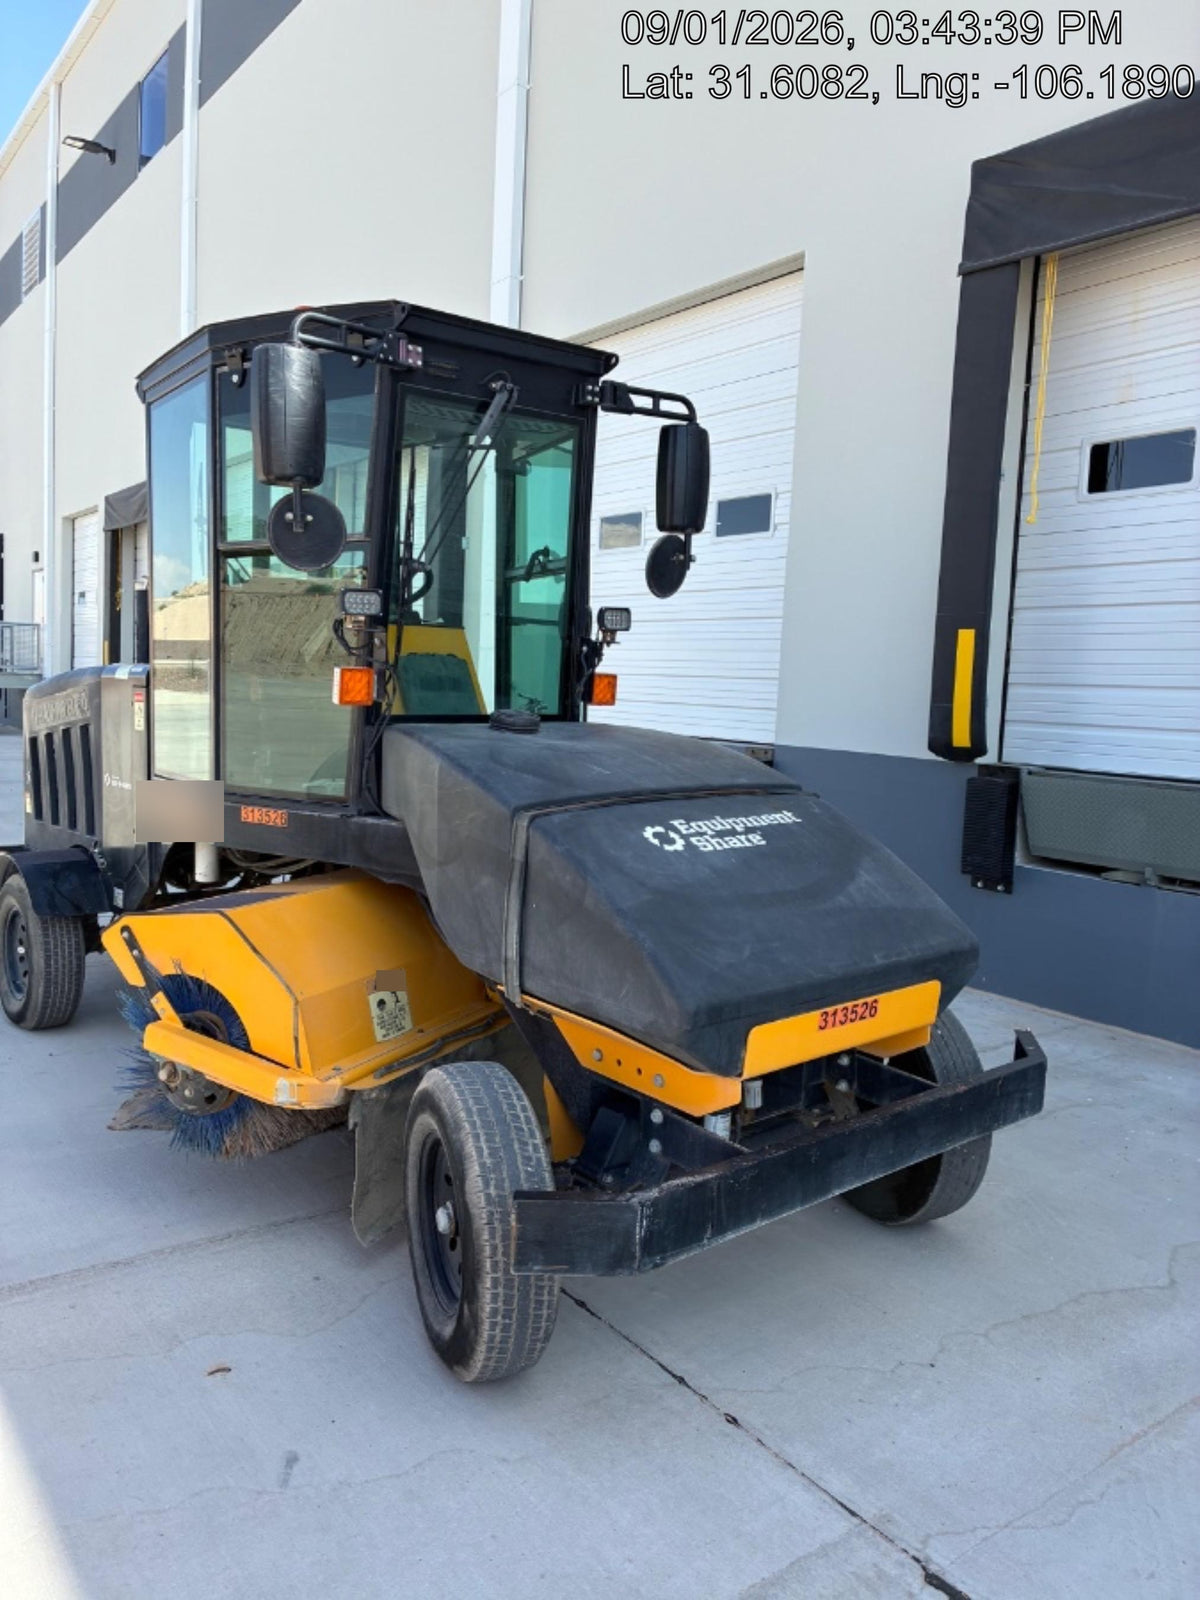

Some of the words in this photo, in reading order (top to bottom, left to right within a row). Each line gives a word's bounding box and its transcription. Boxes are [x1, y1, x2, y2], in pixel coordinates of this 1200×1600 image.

[242, 806, 287, 826] 313526
[669, 810, 802, 834] Equipment
[689, 831, 767, 852] Share
[818, 999, 879, 1031] 313526
